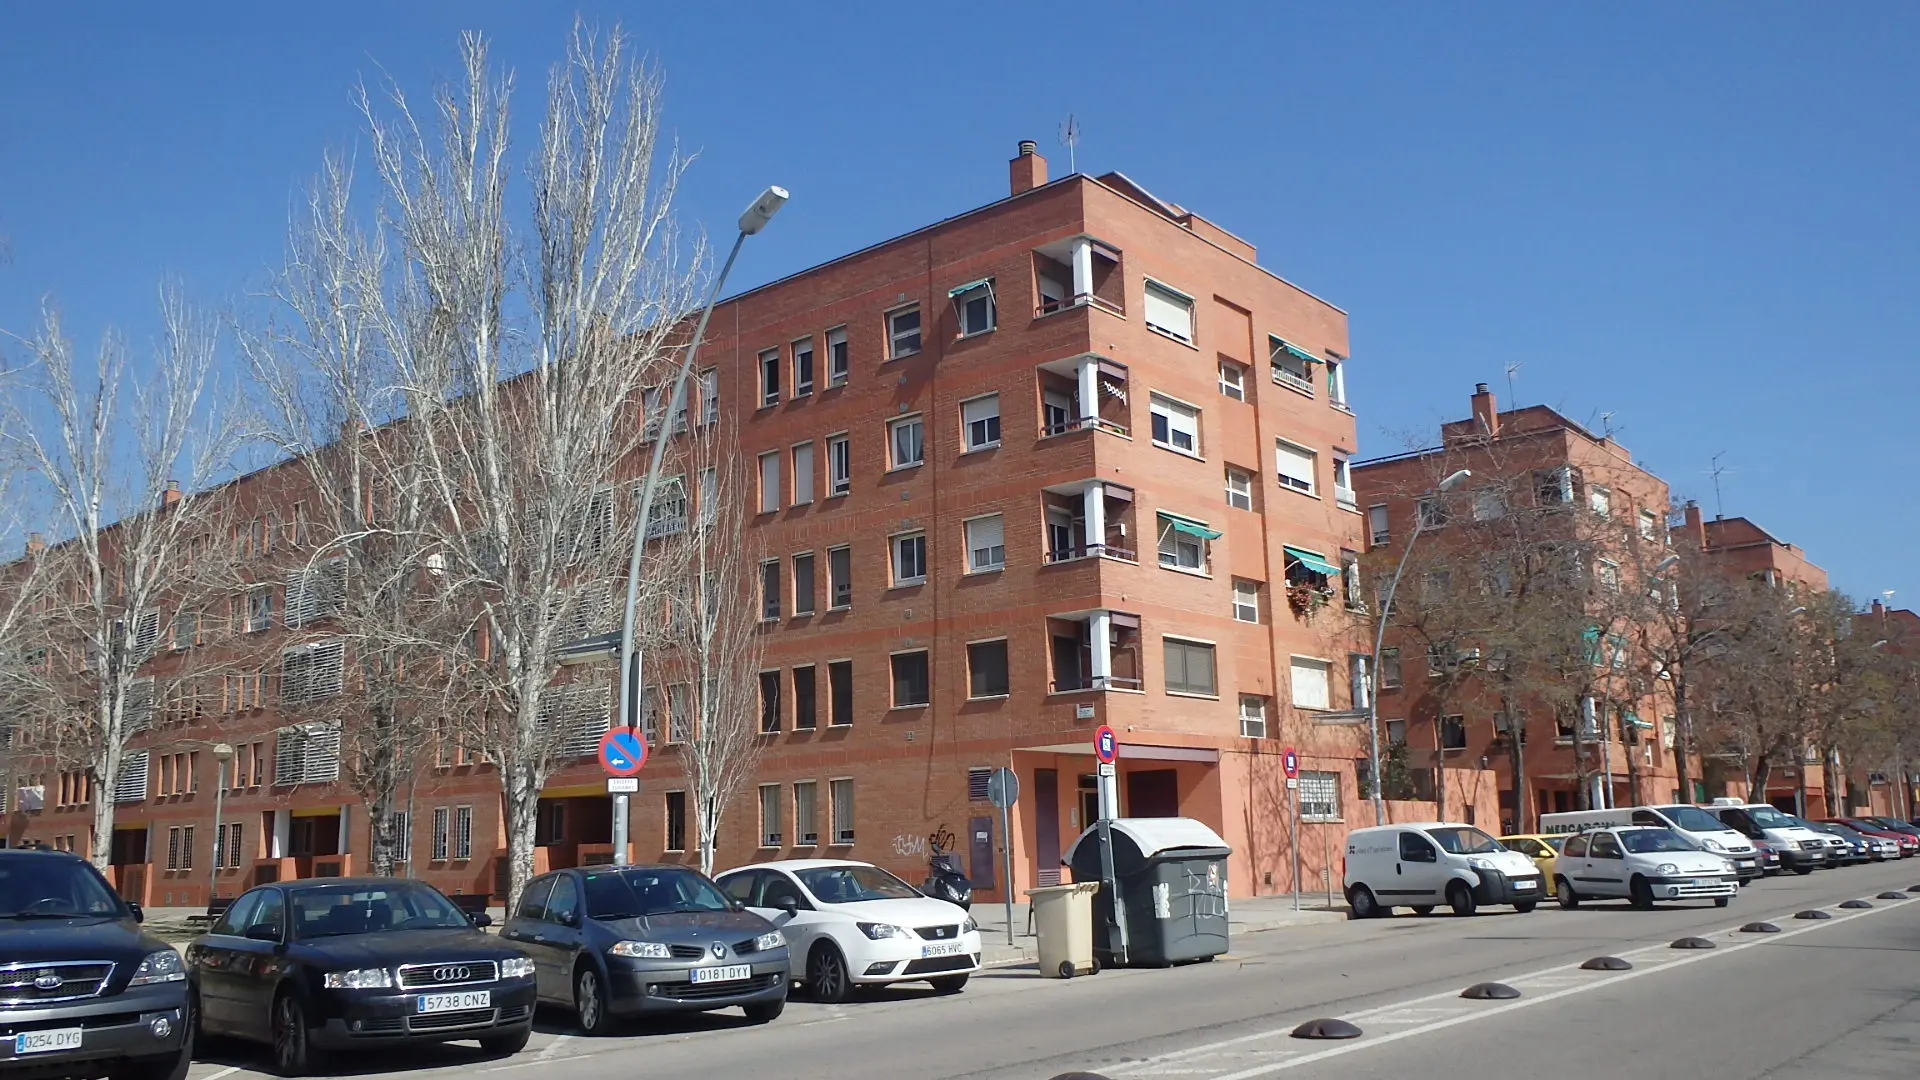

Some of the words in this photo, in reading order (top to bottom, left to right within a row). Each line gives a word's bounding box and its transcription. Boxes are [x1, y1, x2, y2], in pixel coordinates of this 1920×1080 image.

[927, 945, 947, 956] 6065
[948, 943, 962, 954] HVC
[699, 967, 725, 980] 0181
[729, 966, 748, 978] DYY
[427, 995, 460, 1010] 5738
[464, 993, 488, 1007] CNZ
[24, 1035, 52, 1048] 0254
[56, 1032, 80, 1046] DYG
